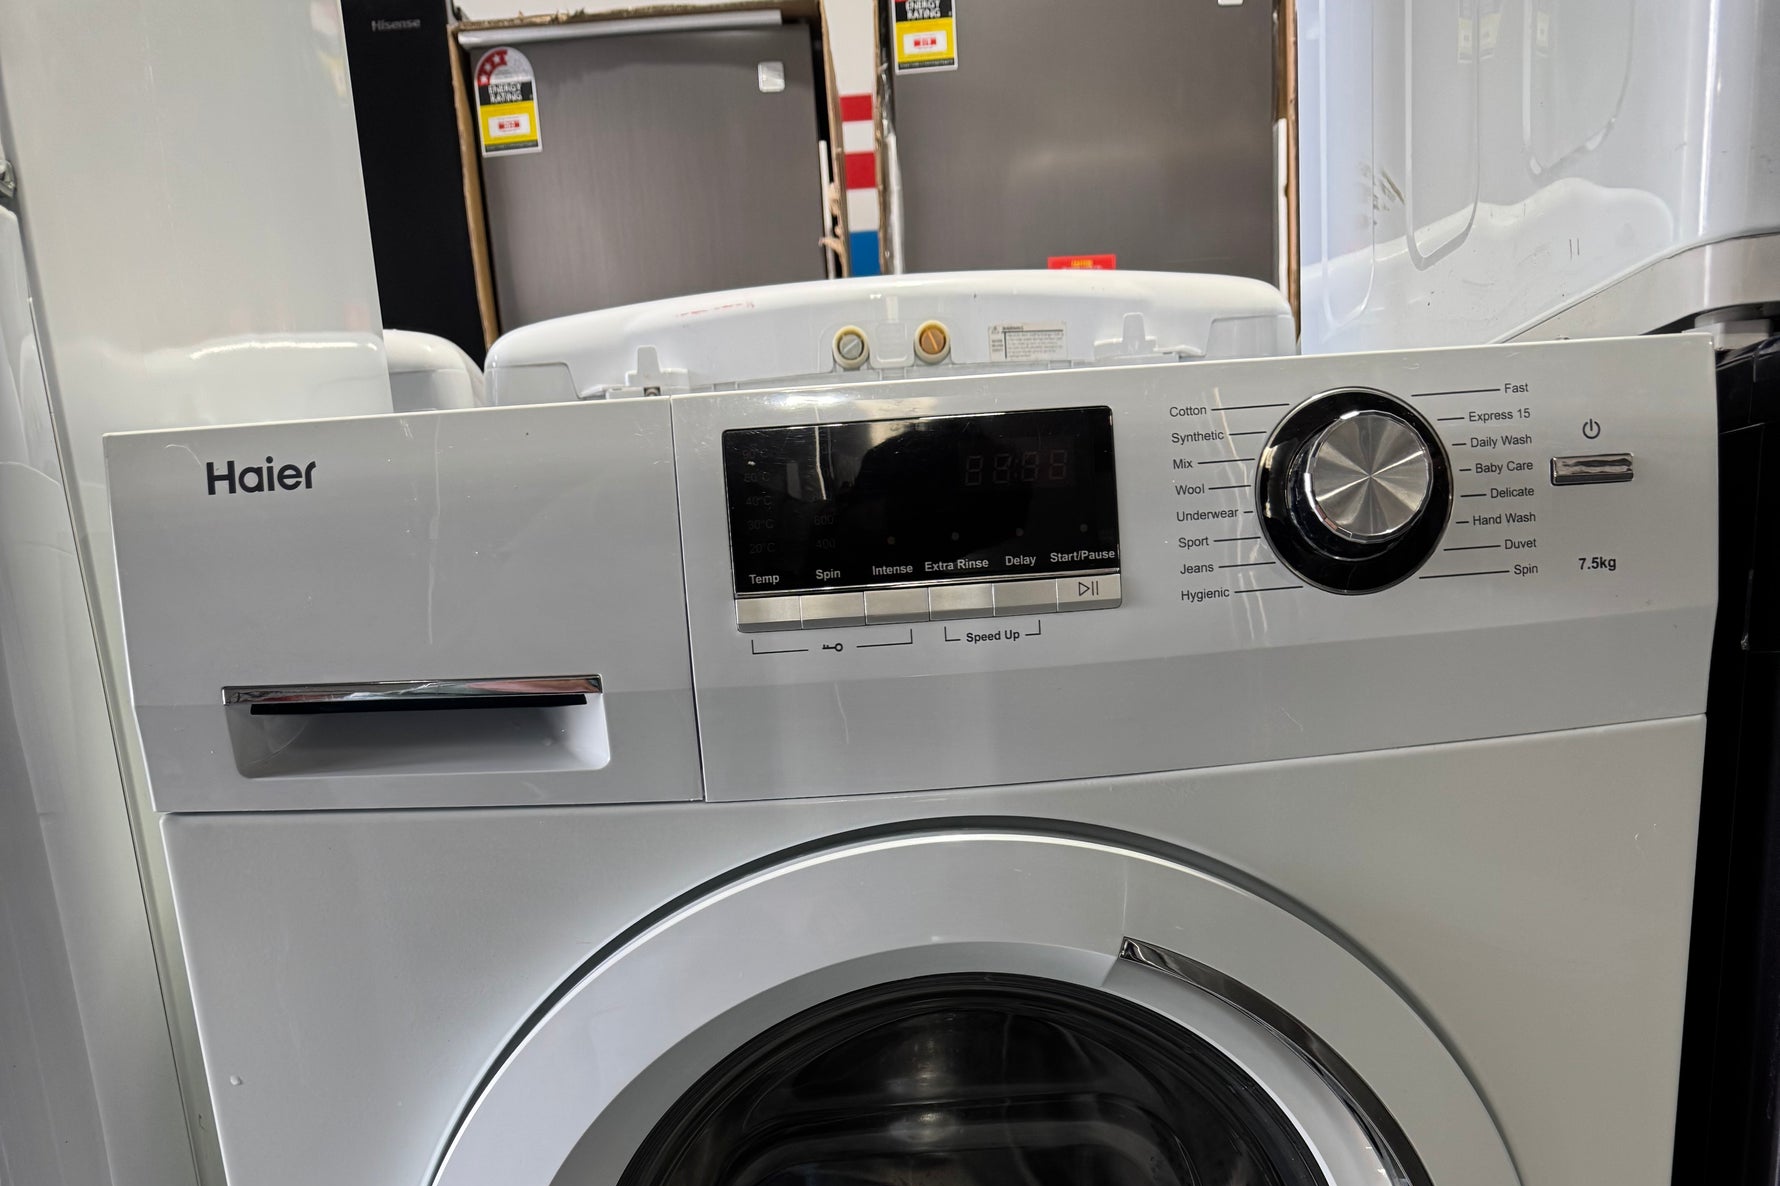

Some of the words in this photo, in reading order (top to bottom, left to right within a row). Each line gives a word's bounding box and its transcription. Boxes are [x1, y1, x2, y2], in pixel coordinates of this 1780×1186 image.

[371, 19, 421, 32] Hisense
[1504, 382, 1529, 394] Fast
[1169, 406, 1207, 417] Cotton
[1468, 409, 1513, 424] Express
[1517, 408, 1531, 419] 15
[1171, 430, 1224, 446] Synthetic
[1470, 436, 1498, 449] Daily
[1501, 434, 1532, 446] Wash
[1173, 458, 1193, 470] Mix
[1475, 462, 1503, 475] Baby
[1506, 460, 1534, 472] Care
[206, 456, 317, 495] Haier
[1175, 483, 1205, 496] Wool
[1490, 486, 1535, 499] Delicate
[1176, 508, 1239, 522] Underwear
[1472, 513, 1501, 526] Hand
[1505, 511, 1536, 524] Wash
[1178, 536, 1209, 549] Sport
[1504, 538, 1537, 550] Duvet
[1005, 555, 1036, 566] Delay
[1050, 550, 1115, 562] Start/Pause
[872, 564, 913, 576] Intense
[925, 561, 954, 572] Extra
[957, 558, 989, 570] Rinse
[1180, 563, 1214, 575] Jeans
[1514, 563, 1538, 577] Spin
[1578, 556, 1617, 571] 7.5kg
[749, 574, 780, 585] Temp
[816, 569, 841, 581] Spin
[1181, 587, 1230, 603] Hygienic
[966, 630, 1001, 644] Speed
[1004, 629, 1020, 641] Up
